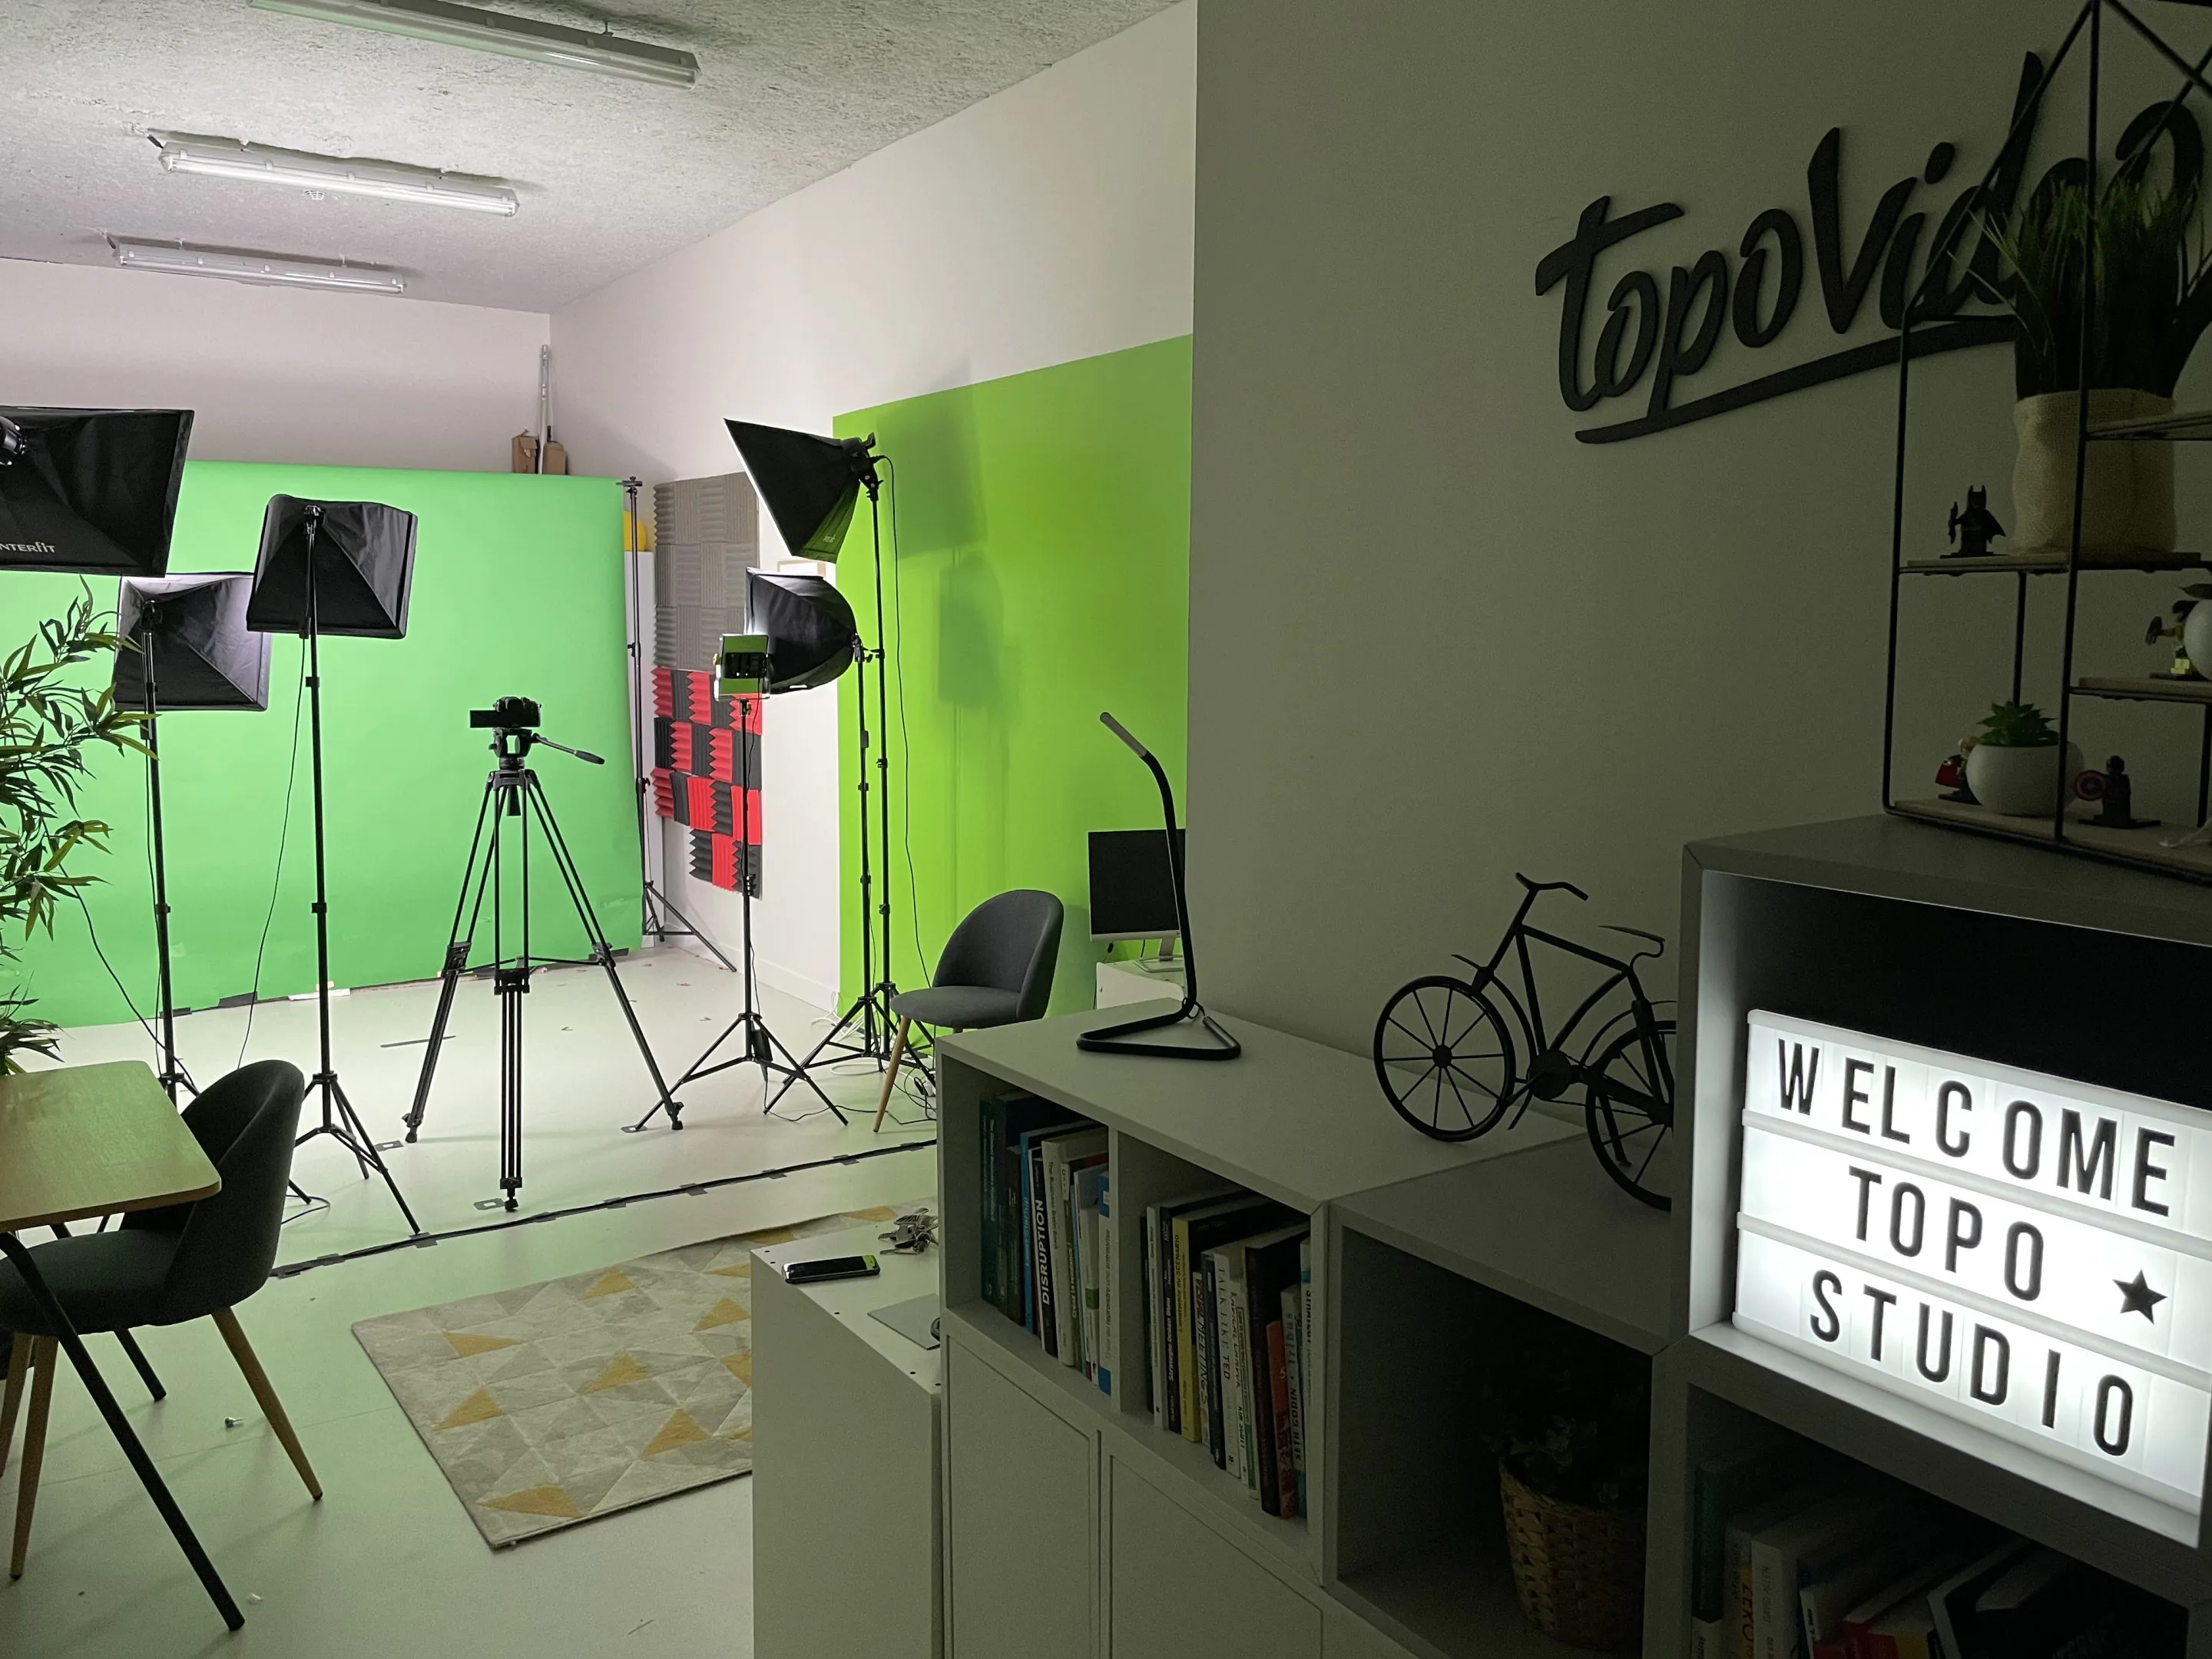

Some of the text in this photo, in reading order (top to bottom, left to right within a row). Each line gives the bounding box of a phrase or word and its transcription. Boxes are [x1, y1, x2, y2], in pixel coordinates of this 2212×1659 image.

[1536, 51, 2204, 419] topoVid
[1777, 1038, 2176, 1217] WELCOME
[1035, 1199, 1051, 1306] DISRUPTION
[1848, 1166, 2044, 1302] TOPO
[1197, 1321, 1207, 1404] MEETINGS
[1218, 1268, 1231, 1379] TALK LIKE TED
[1810, 1269, 2134, 1456] STUDIO
[1290, 1387, 1299, 1427] GODIN
[1291, 1431, 1301, 1461] SETH
